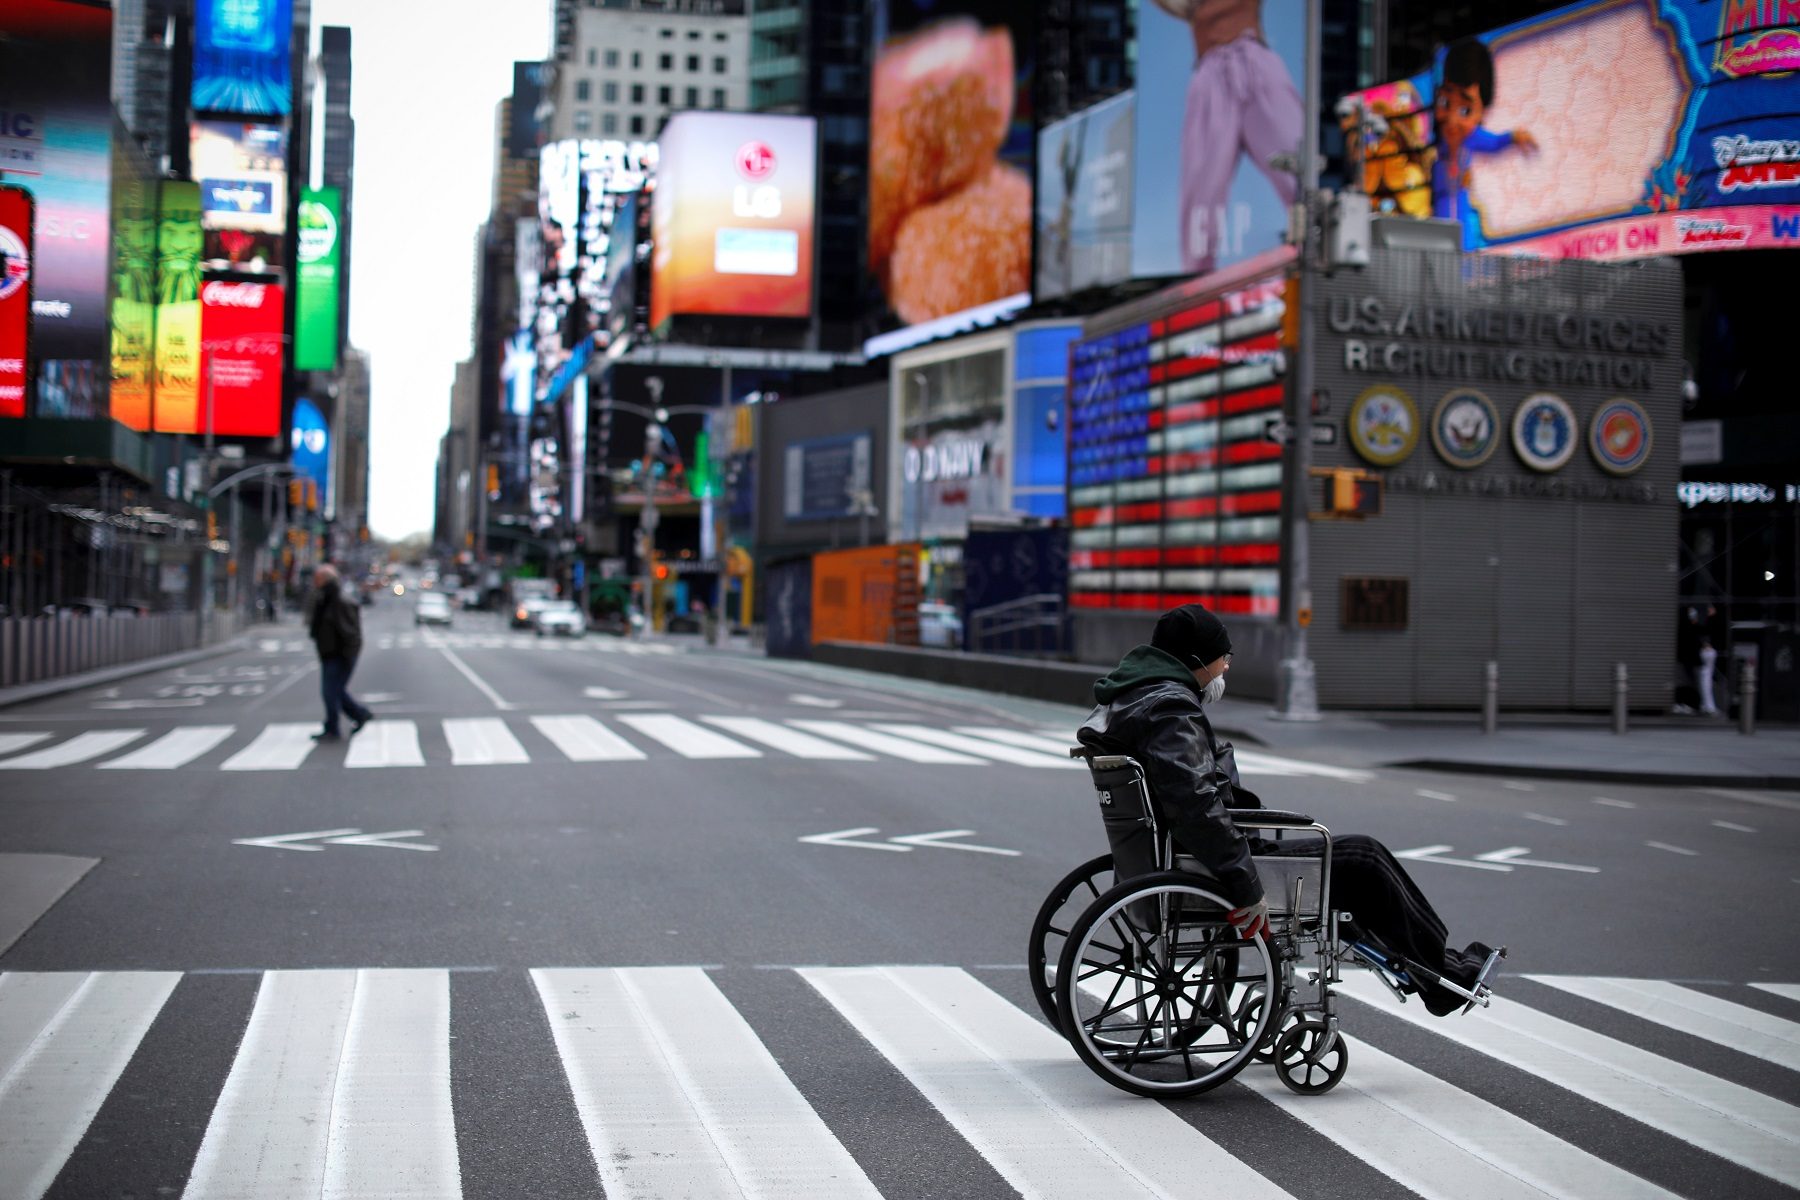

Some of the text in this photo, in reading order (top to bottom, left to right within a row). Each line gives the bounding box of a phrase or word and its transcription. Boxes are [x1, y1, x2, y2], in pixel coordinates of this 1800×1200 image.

[733, 184, 781, 219] LG
[1345, 338, 1531, 382] RECRUITNG
[904, 446, 938, 483] OD
